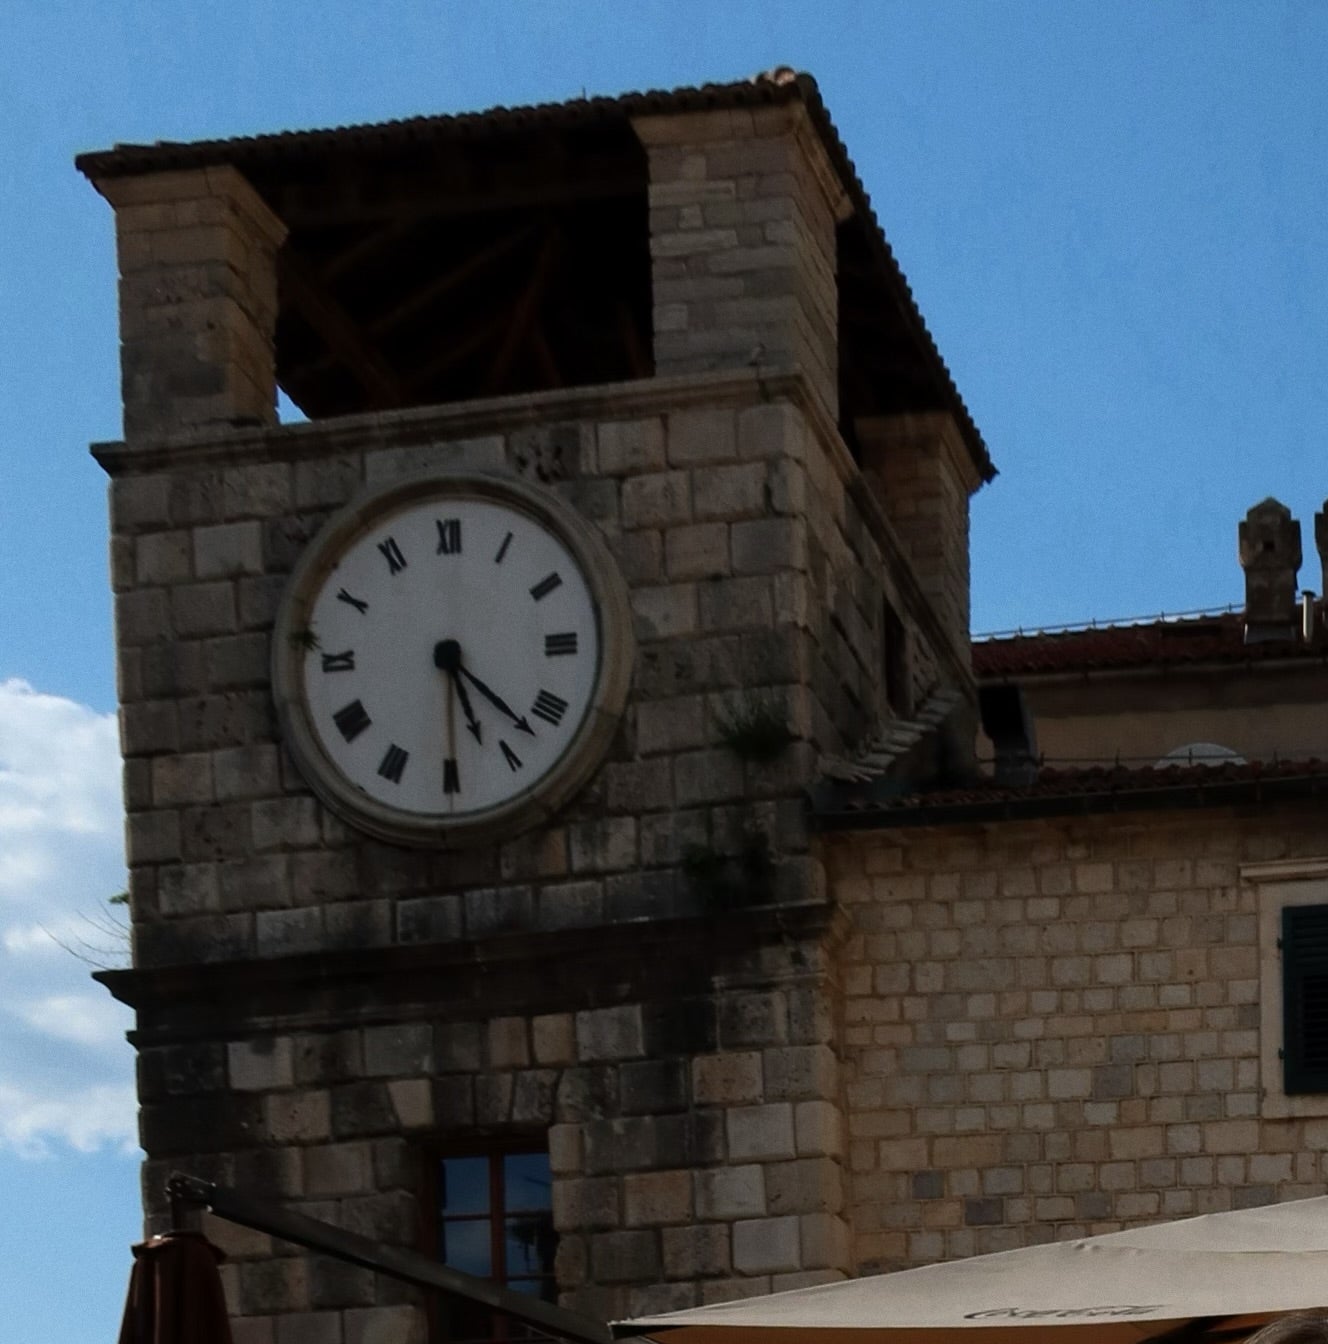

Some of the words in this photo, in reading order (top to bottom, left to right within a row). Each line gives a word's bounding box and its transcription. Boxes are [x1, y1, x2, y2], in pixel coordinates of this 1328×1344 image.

[436, 519, 461, 554] XII
[378, 537, 407, 575] XI
[336, 588, 368, 614] X
[545, 632, 577, 656] III
[531, 689, 569, 726] IIII
[499, 740, 523, 772] V
